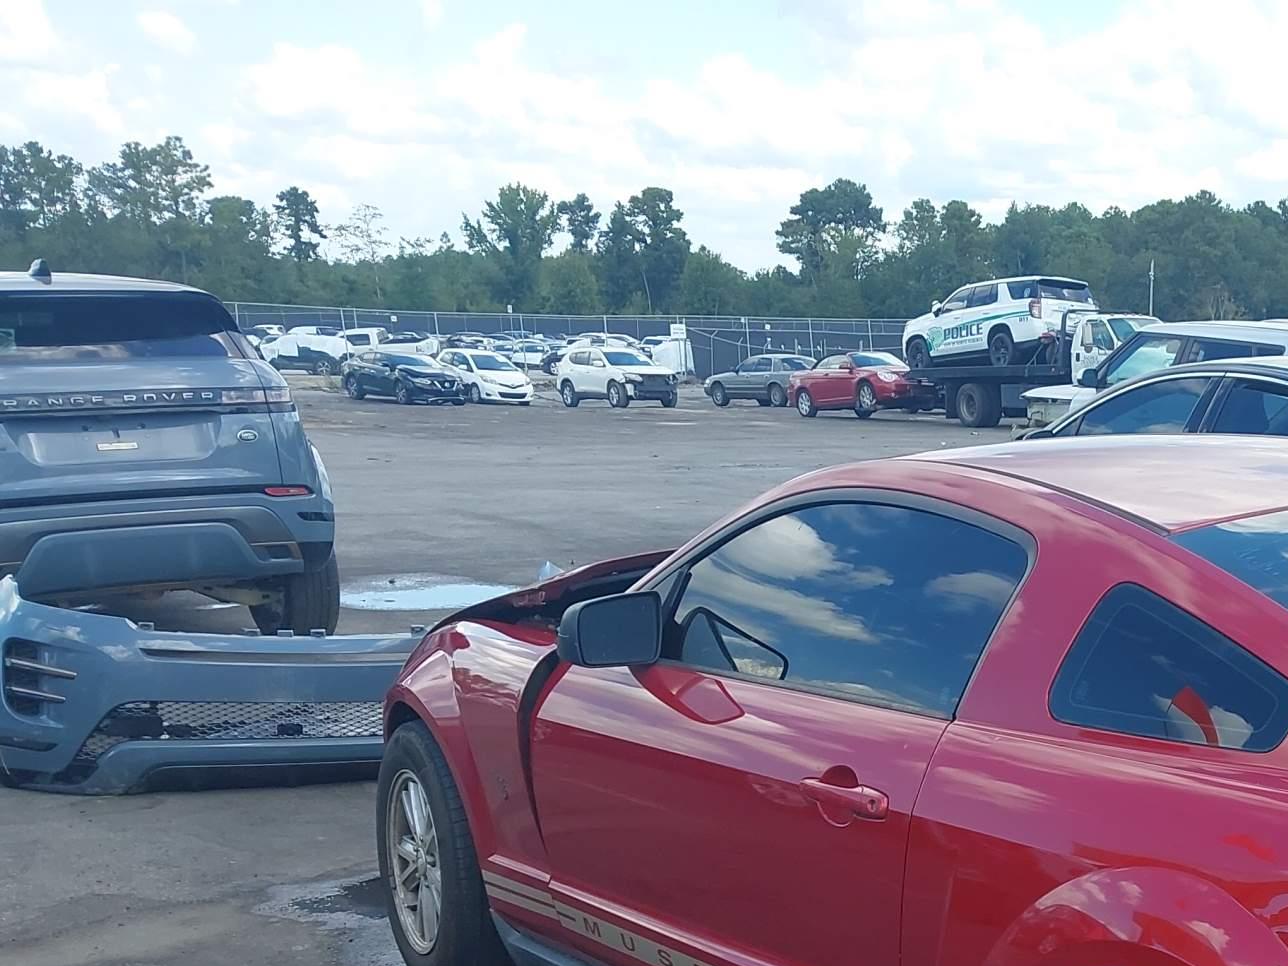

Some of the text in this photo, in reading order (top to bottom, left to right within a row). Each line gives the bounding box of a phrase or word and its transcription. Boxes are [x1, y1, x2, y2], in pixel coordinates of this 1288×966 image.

[943, 322, 983, 341] POLICE
[3, 391, 214, 408] RANGE ROVER
